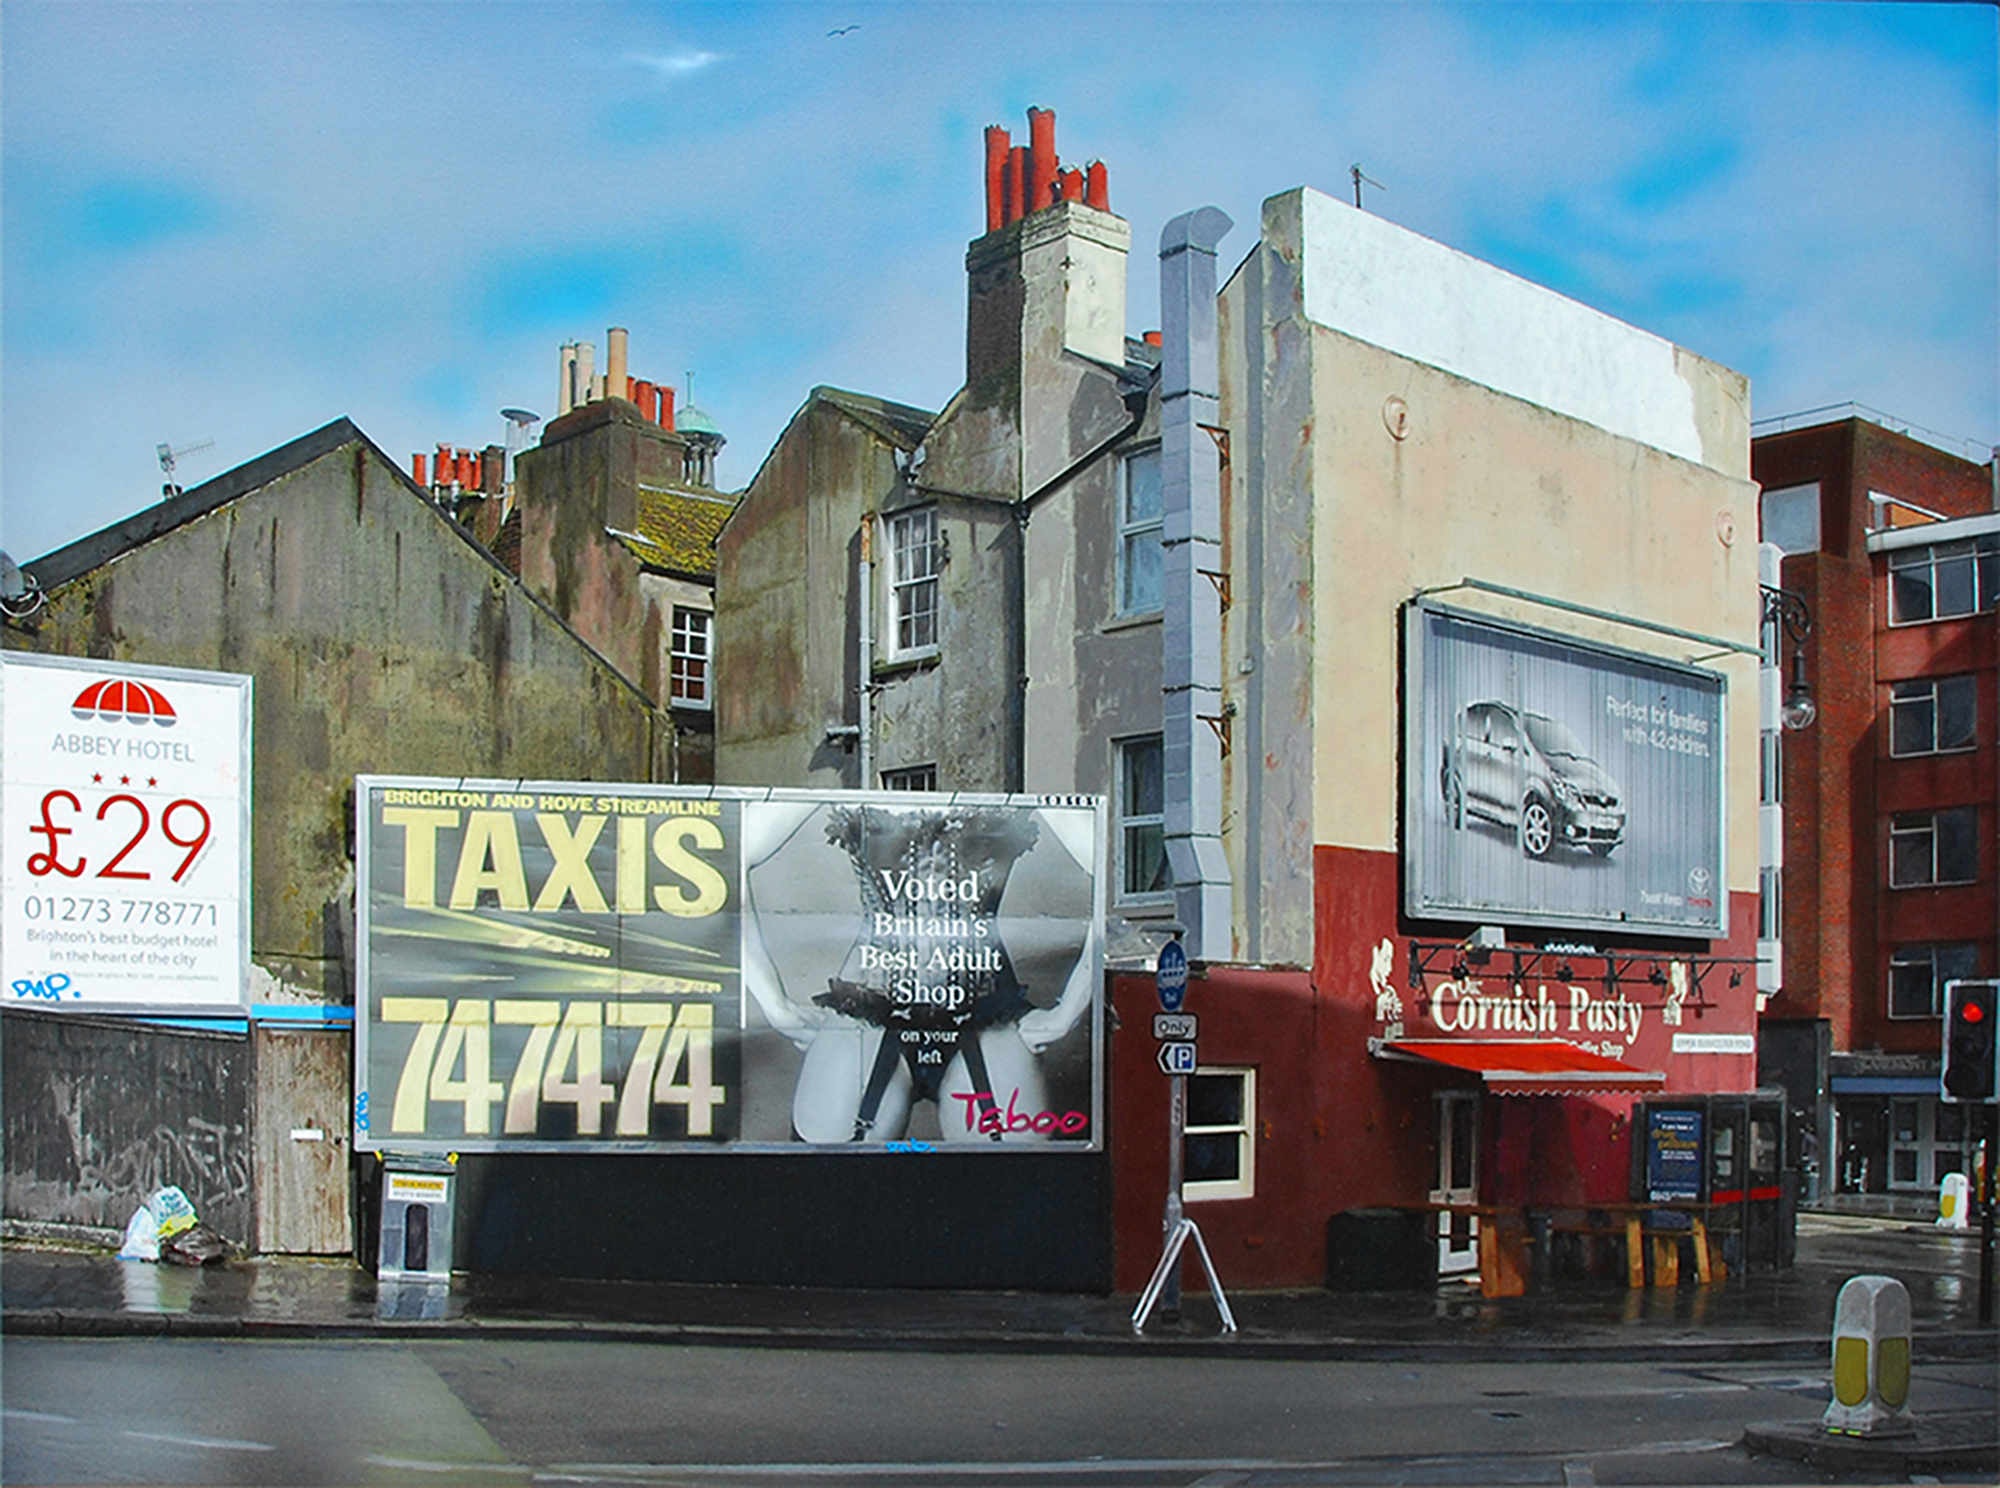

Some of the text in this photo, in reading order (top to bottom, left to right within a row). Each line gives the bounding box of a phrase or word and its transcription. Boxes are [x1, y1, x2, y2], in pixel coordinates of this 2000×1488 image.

[52, 733, 195, 763] ABBEY HOTEL
[384, 789, 721, 817] BRIGHTON AND HOVE STREAMLINE
[27, 789, 211, 883] £29
[382, 809, 728, 919] TAXIS
[882, 869, 980, 902] Voted
[24, 895, 217, 927] 01273 778771
[873, 912, 988, 938] Britain's
[27, 928, 218, 948] Brighton's best budget hotel
[50, 949, 197, 969] in the heart of the city
[859, 945, 1003, 971] Best Adult
[896, 978, 965, 1010] Shop
[1158, 1020, 1191, 1037] Only
[1431, 982, 1643, 1046] Cornish Pasty
[900, 1030, 960, 1046] on your
[381, 998, 725, 1137] 747474
[917, 1050, 943, 1065] left
[1178, 1048, 1191, 1068] P
[951, 1088, 1089, 1134] Taboo
